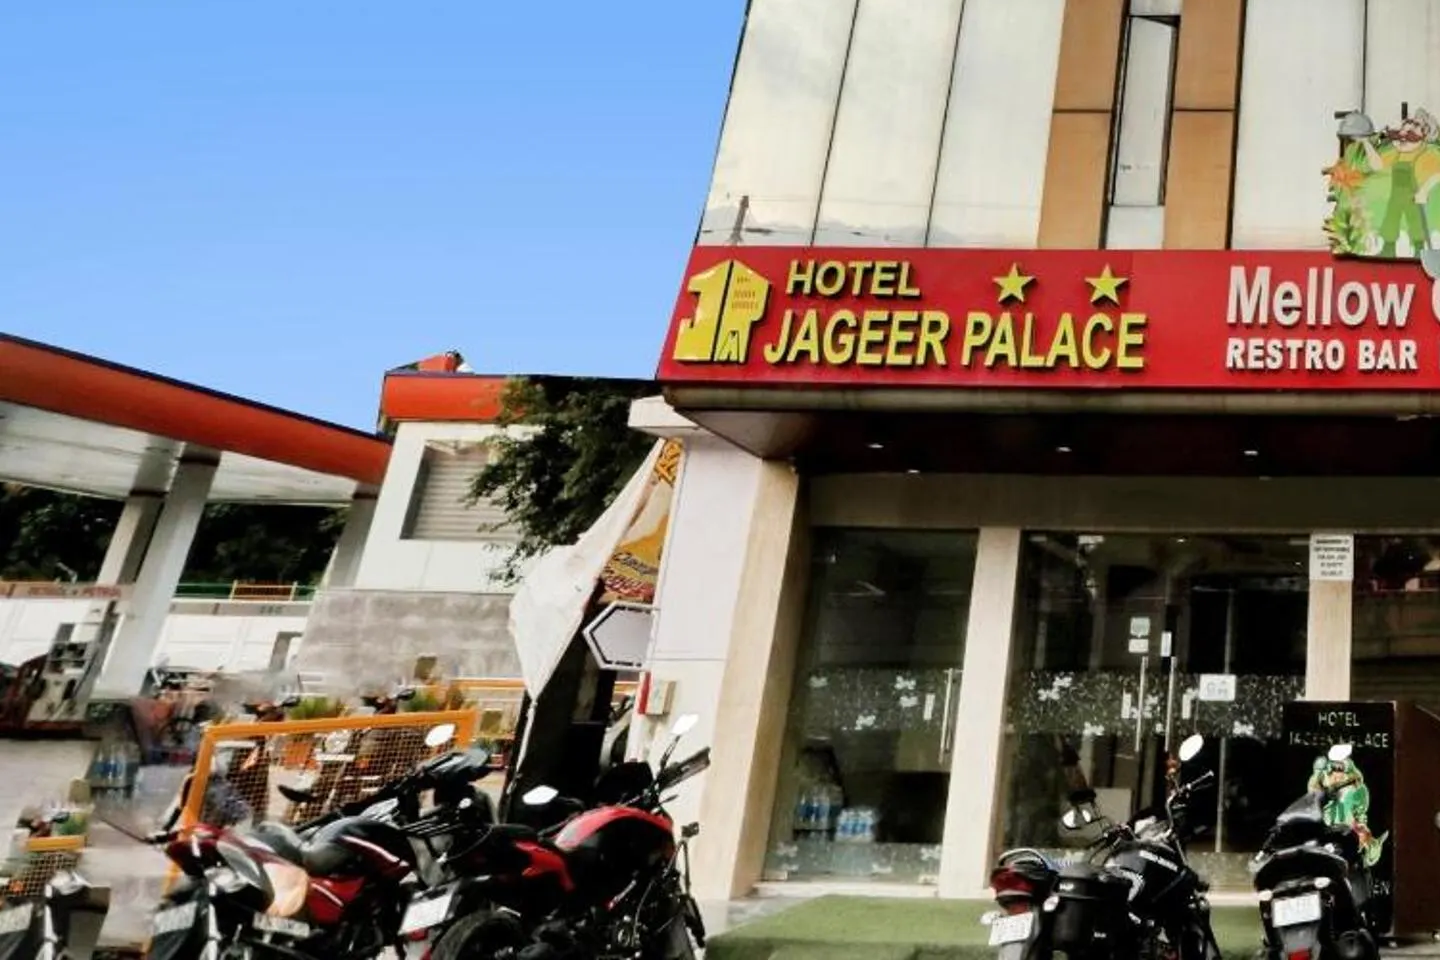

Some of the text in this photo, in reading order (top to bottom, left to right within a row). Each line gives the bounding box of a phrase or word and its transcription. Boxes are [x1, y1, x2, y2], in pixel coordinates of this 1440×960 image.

[785, 259, 921, 297] HOTEL
[1226, 265, 1415, 327] Mellow
[763, 308, 1147, 370] JAGEER PALACE
[1226, 337, 1345, 371] RESTRO
[1357, 339, 1418, 371] BAR
[1317, 711, 1361, 728] HOTEL
